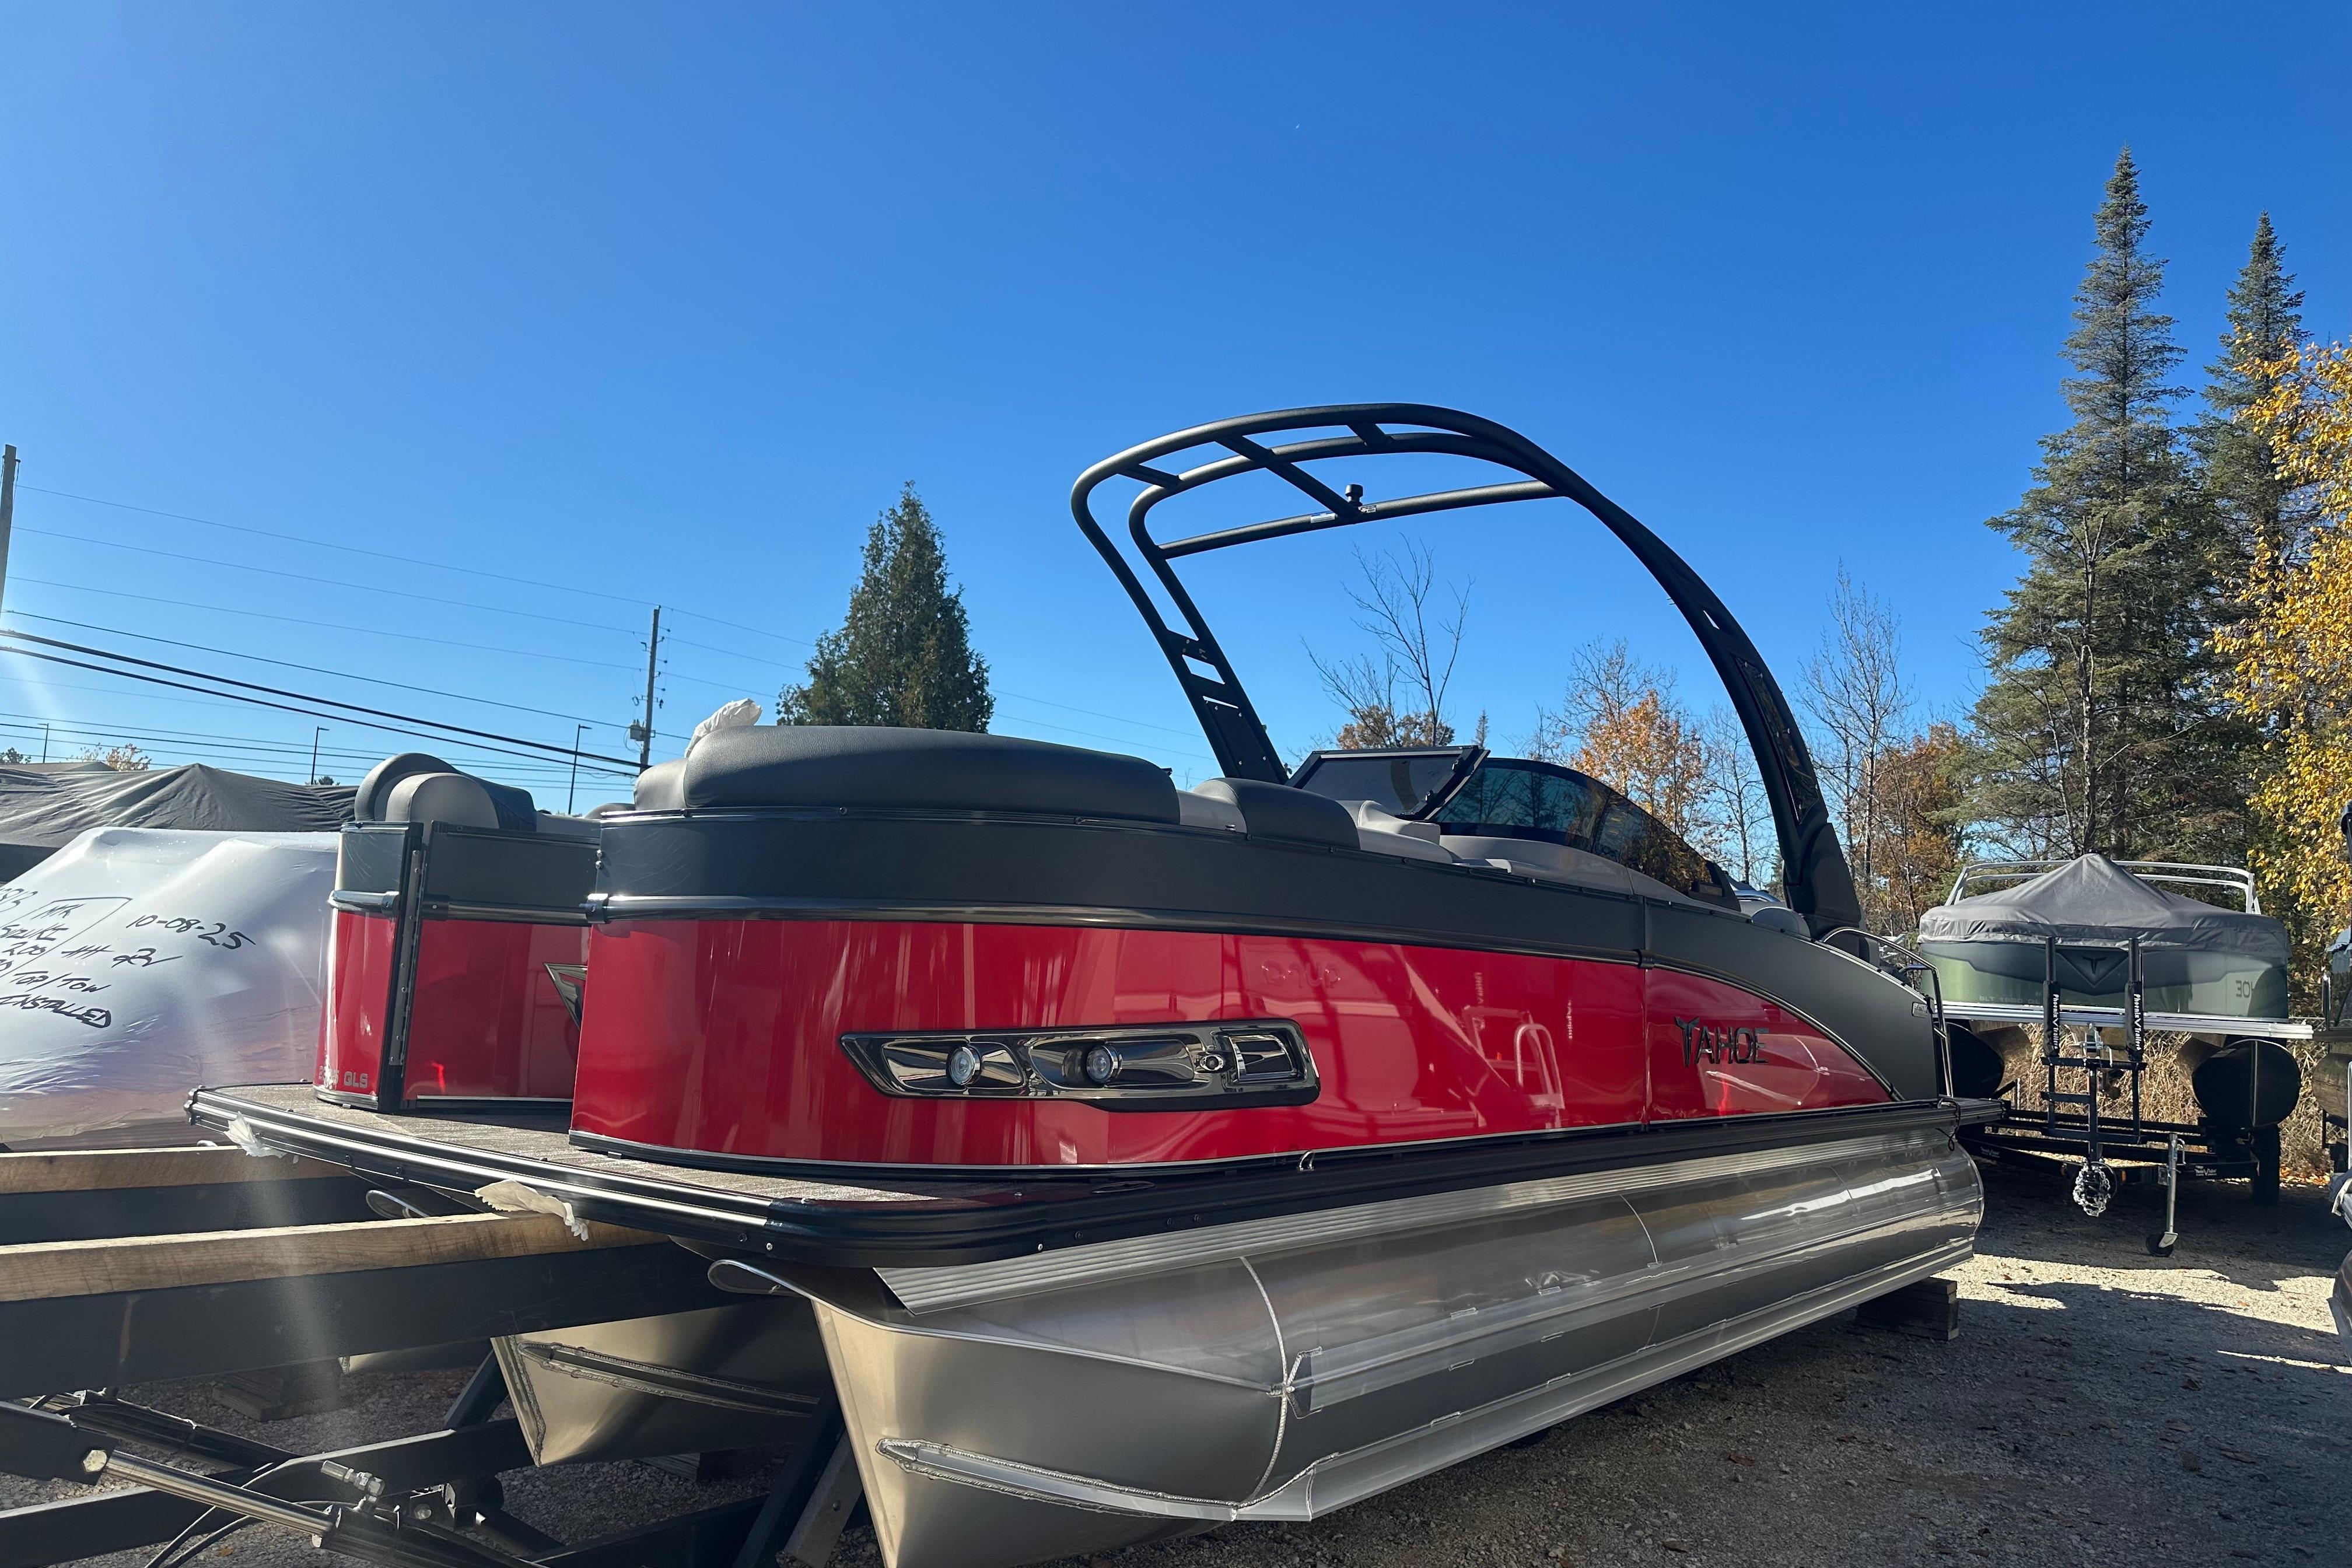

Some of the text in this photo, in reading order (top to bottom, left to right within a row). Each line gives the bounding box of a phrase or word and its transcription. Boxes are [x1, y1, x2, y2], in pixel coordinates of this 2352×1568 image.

[125, 915, 256, 950] 10-08-25
[1674, 1016, 1769, 1068] TAHOE
[344, 1070, 369, 1088] QLS
